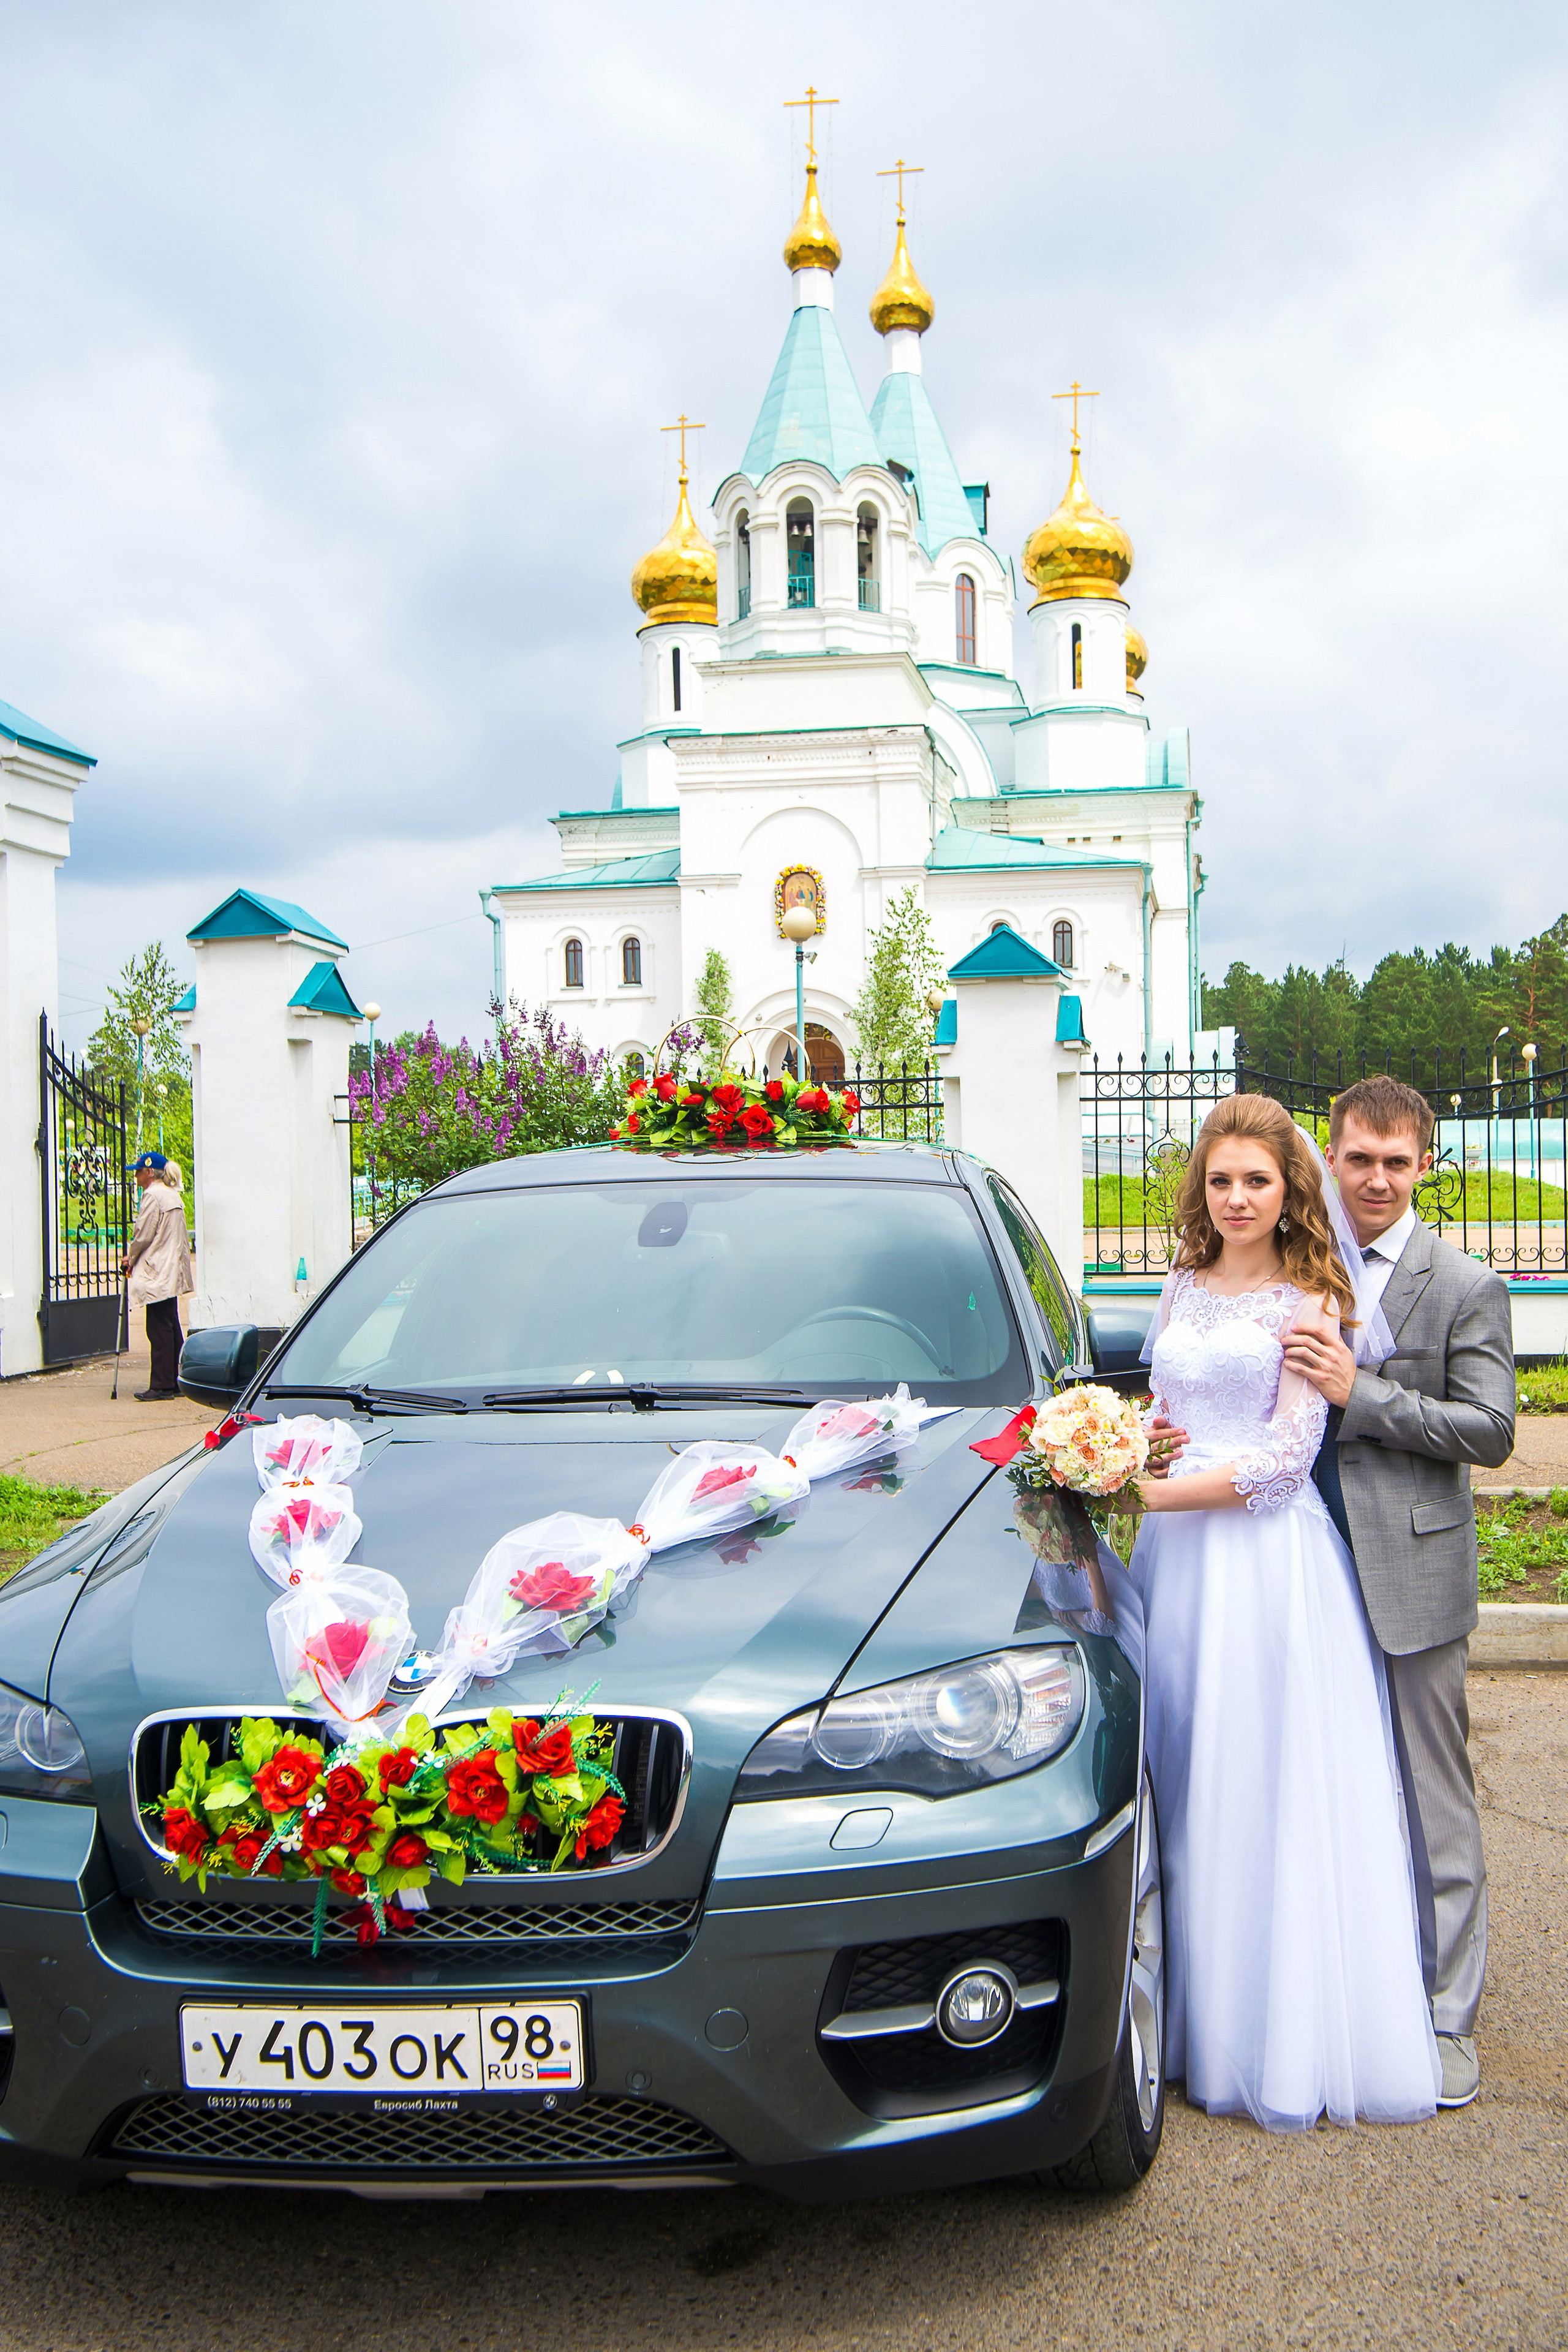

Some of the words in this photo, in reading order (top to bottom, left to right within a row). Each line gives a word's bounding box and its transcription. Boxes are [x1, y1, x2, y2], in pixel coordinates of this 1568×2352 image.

[490, 2015, 554, 2062] 98
[488, 2063, 535, 2080] RUS
[208, 2095, 236, 2109] (812)
[238, 2097, 259, 2108] 740
[374, 2098, 423, 2112] Евросиб
[424, 2098, 458, 2111] Лахта
